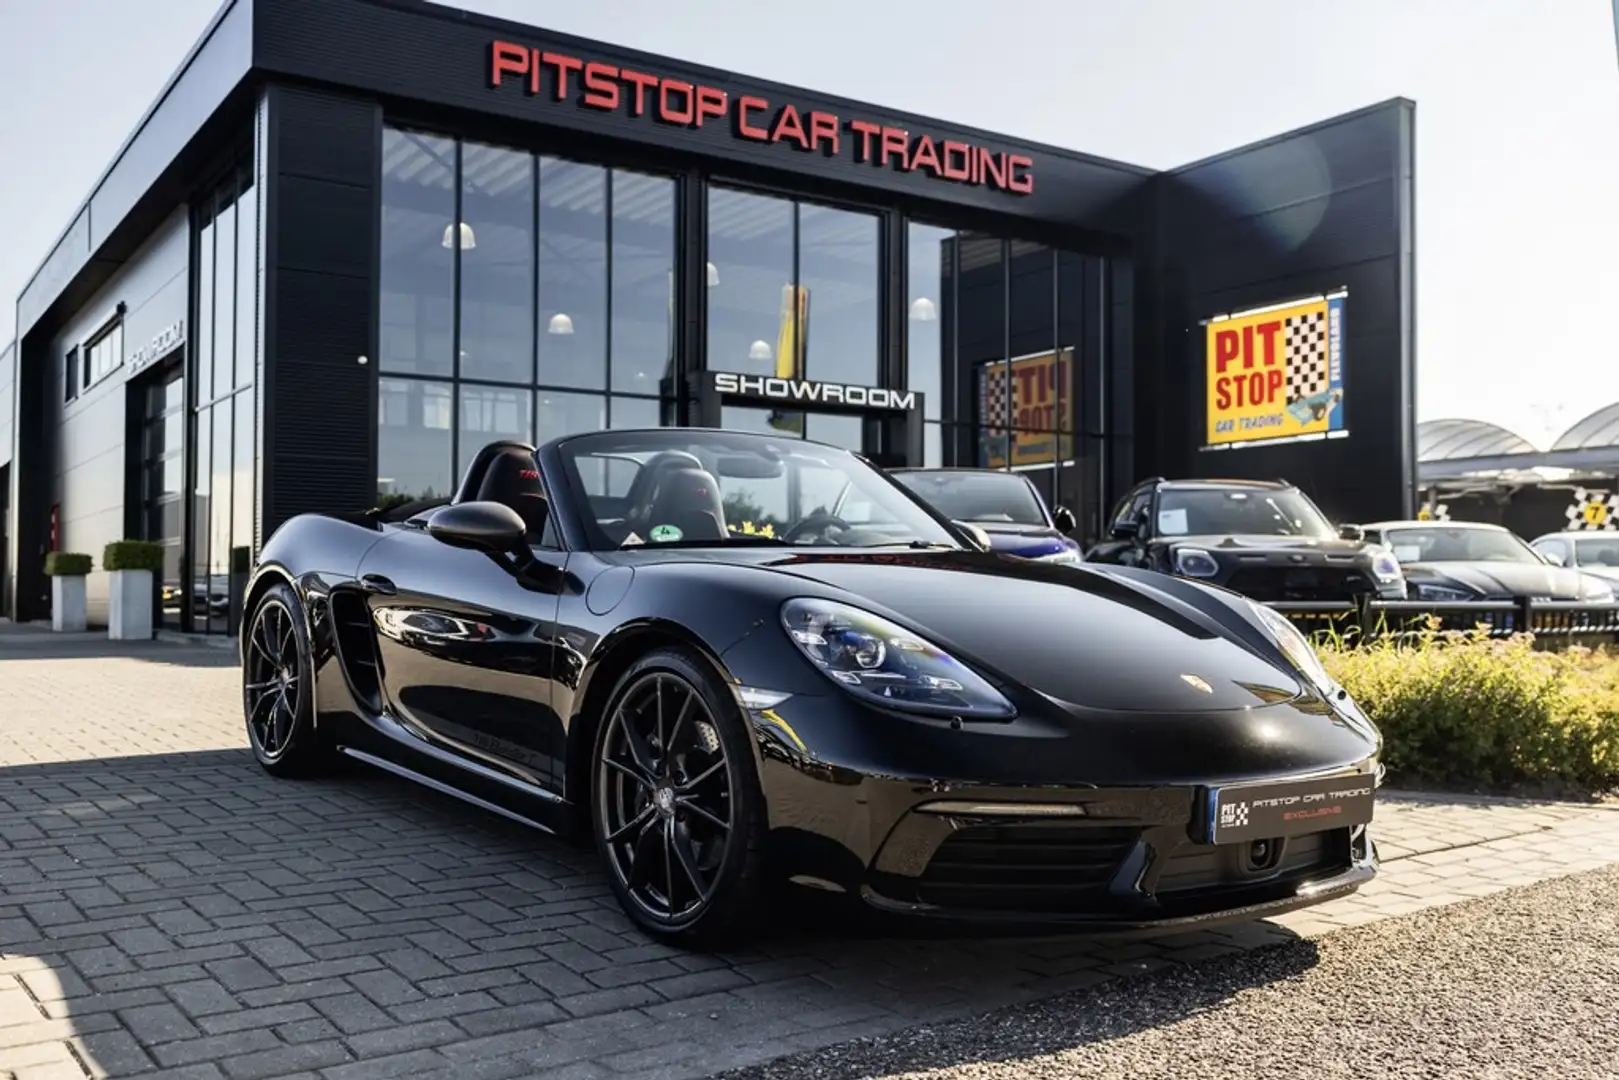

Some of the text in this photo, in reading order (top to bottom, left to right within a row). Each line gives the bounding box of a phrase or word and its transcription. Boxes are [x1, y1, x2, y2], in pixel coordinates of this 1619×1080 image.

[491, 40, 1033, 195] PITSTOP CAR TRADING
[1215, 320, 1281, 374] PIT
[715, 373, 916, 410] SHOWROOM
[1215, 369, 1282, 411] STOP
[1215, 413, 1284, 433] CAR TRADING
[1590, 506, 1600, 520] 7
[1252, 788, 1371, 808] PITSTOP CAR TRADING
[1220, 814, 1236, 824] STOP
[1221, 803, 1236, 815] PIT
